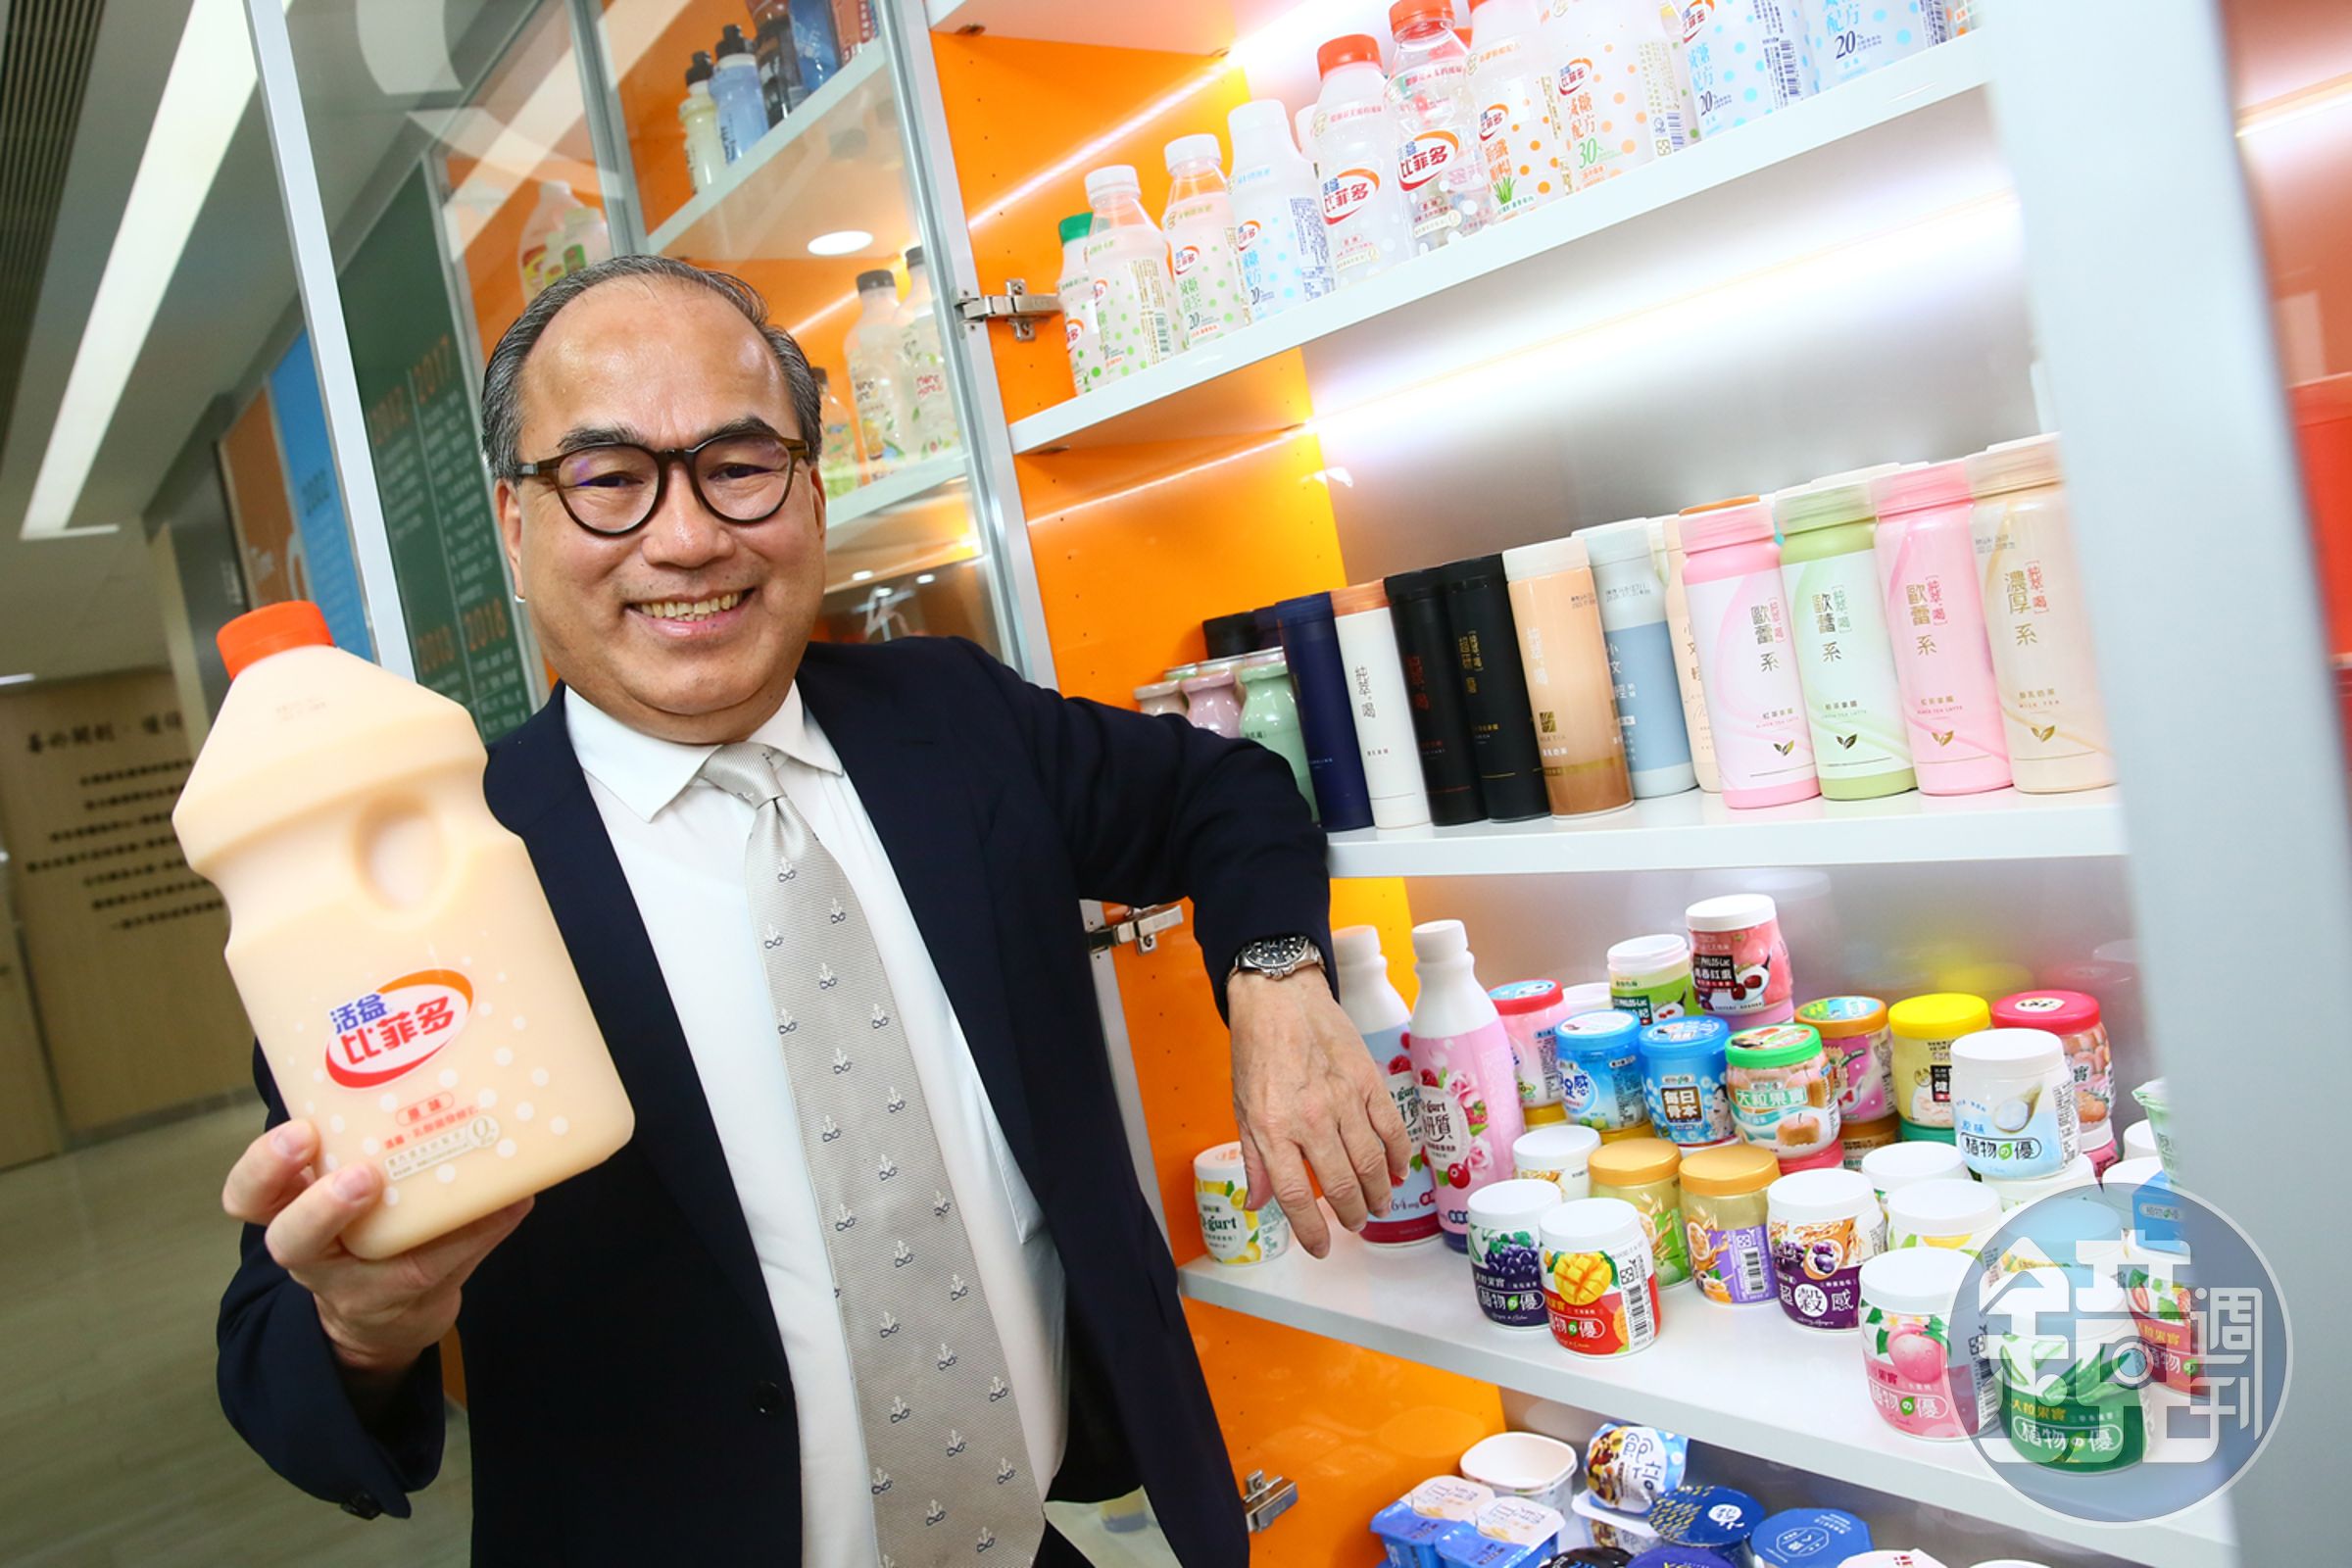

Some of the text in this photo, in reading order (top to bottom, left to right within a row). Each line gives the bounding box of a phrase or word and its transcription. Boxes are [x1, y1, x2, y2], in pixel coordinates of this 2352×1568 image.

[1401, 145, 1447, 178] 比菲多
[1324, 182, 1368, 213] 比菲多
[1751, 604, 1780, 673] 歐蕾系
[1812, 593, 1842, 662] 歐蕾系
[1906, 584, 1937, 657] 歐蕾系
[329, 992, 388, 1035] 活益
[340, 995, 455, 1065] 比菲多
[1663, 1089, 1696, 1105] 每日
[1965, 1136, 2035, 1161] 植物の優
[2021, 1422, 2115, 1452] 植物の優
